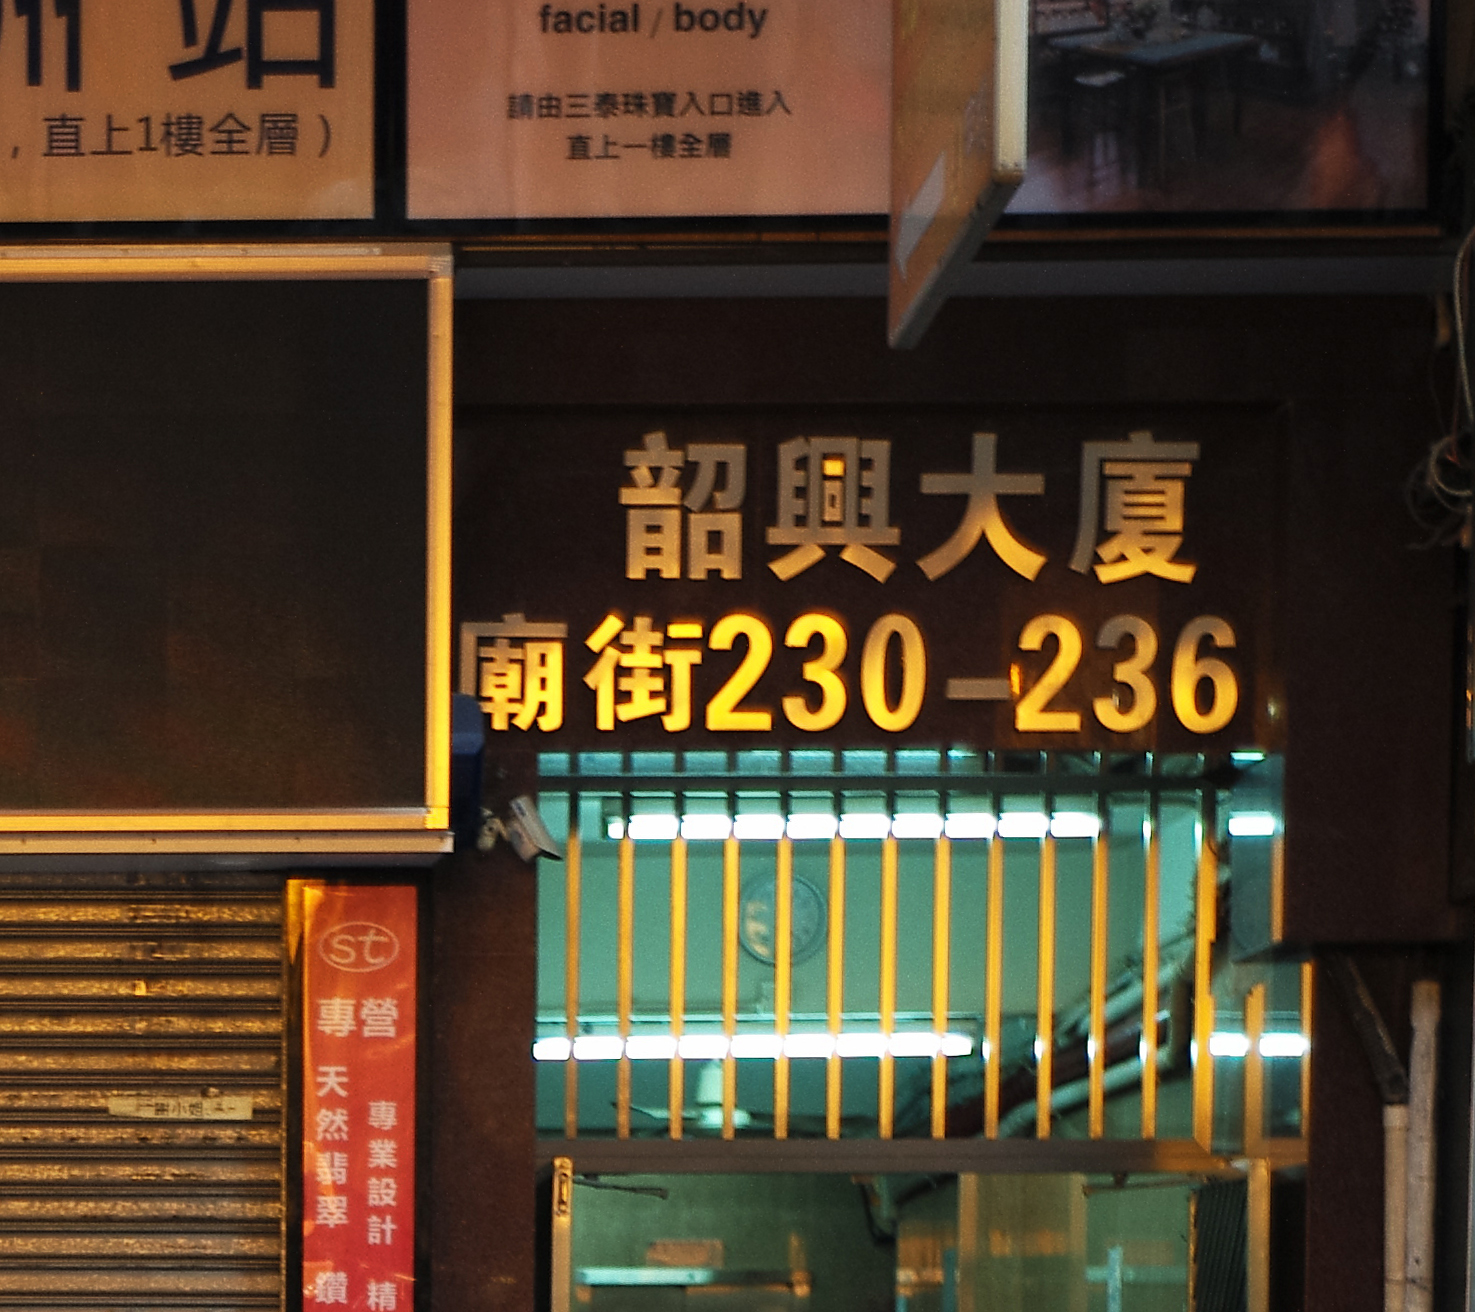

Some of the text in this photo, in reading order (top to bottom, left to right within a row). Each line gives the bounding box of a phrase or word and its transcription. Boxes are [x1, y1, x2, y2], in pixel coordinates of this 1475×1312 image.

[539, 3, 640, 33] facial
[674, 2, 768, 39] body
[617, 430, 1201, 586] 韶興大廈
[316, 996, 399, 1039] 專營
